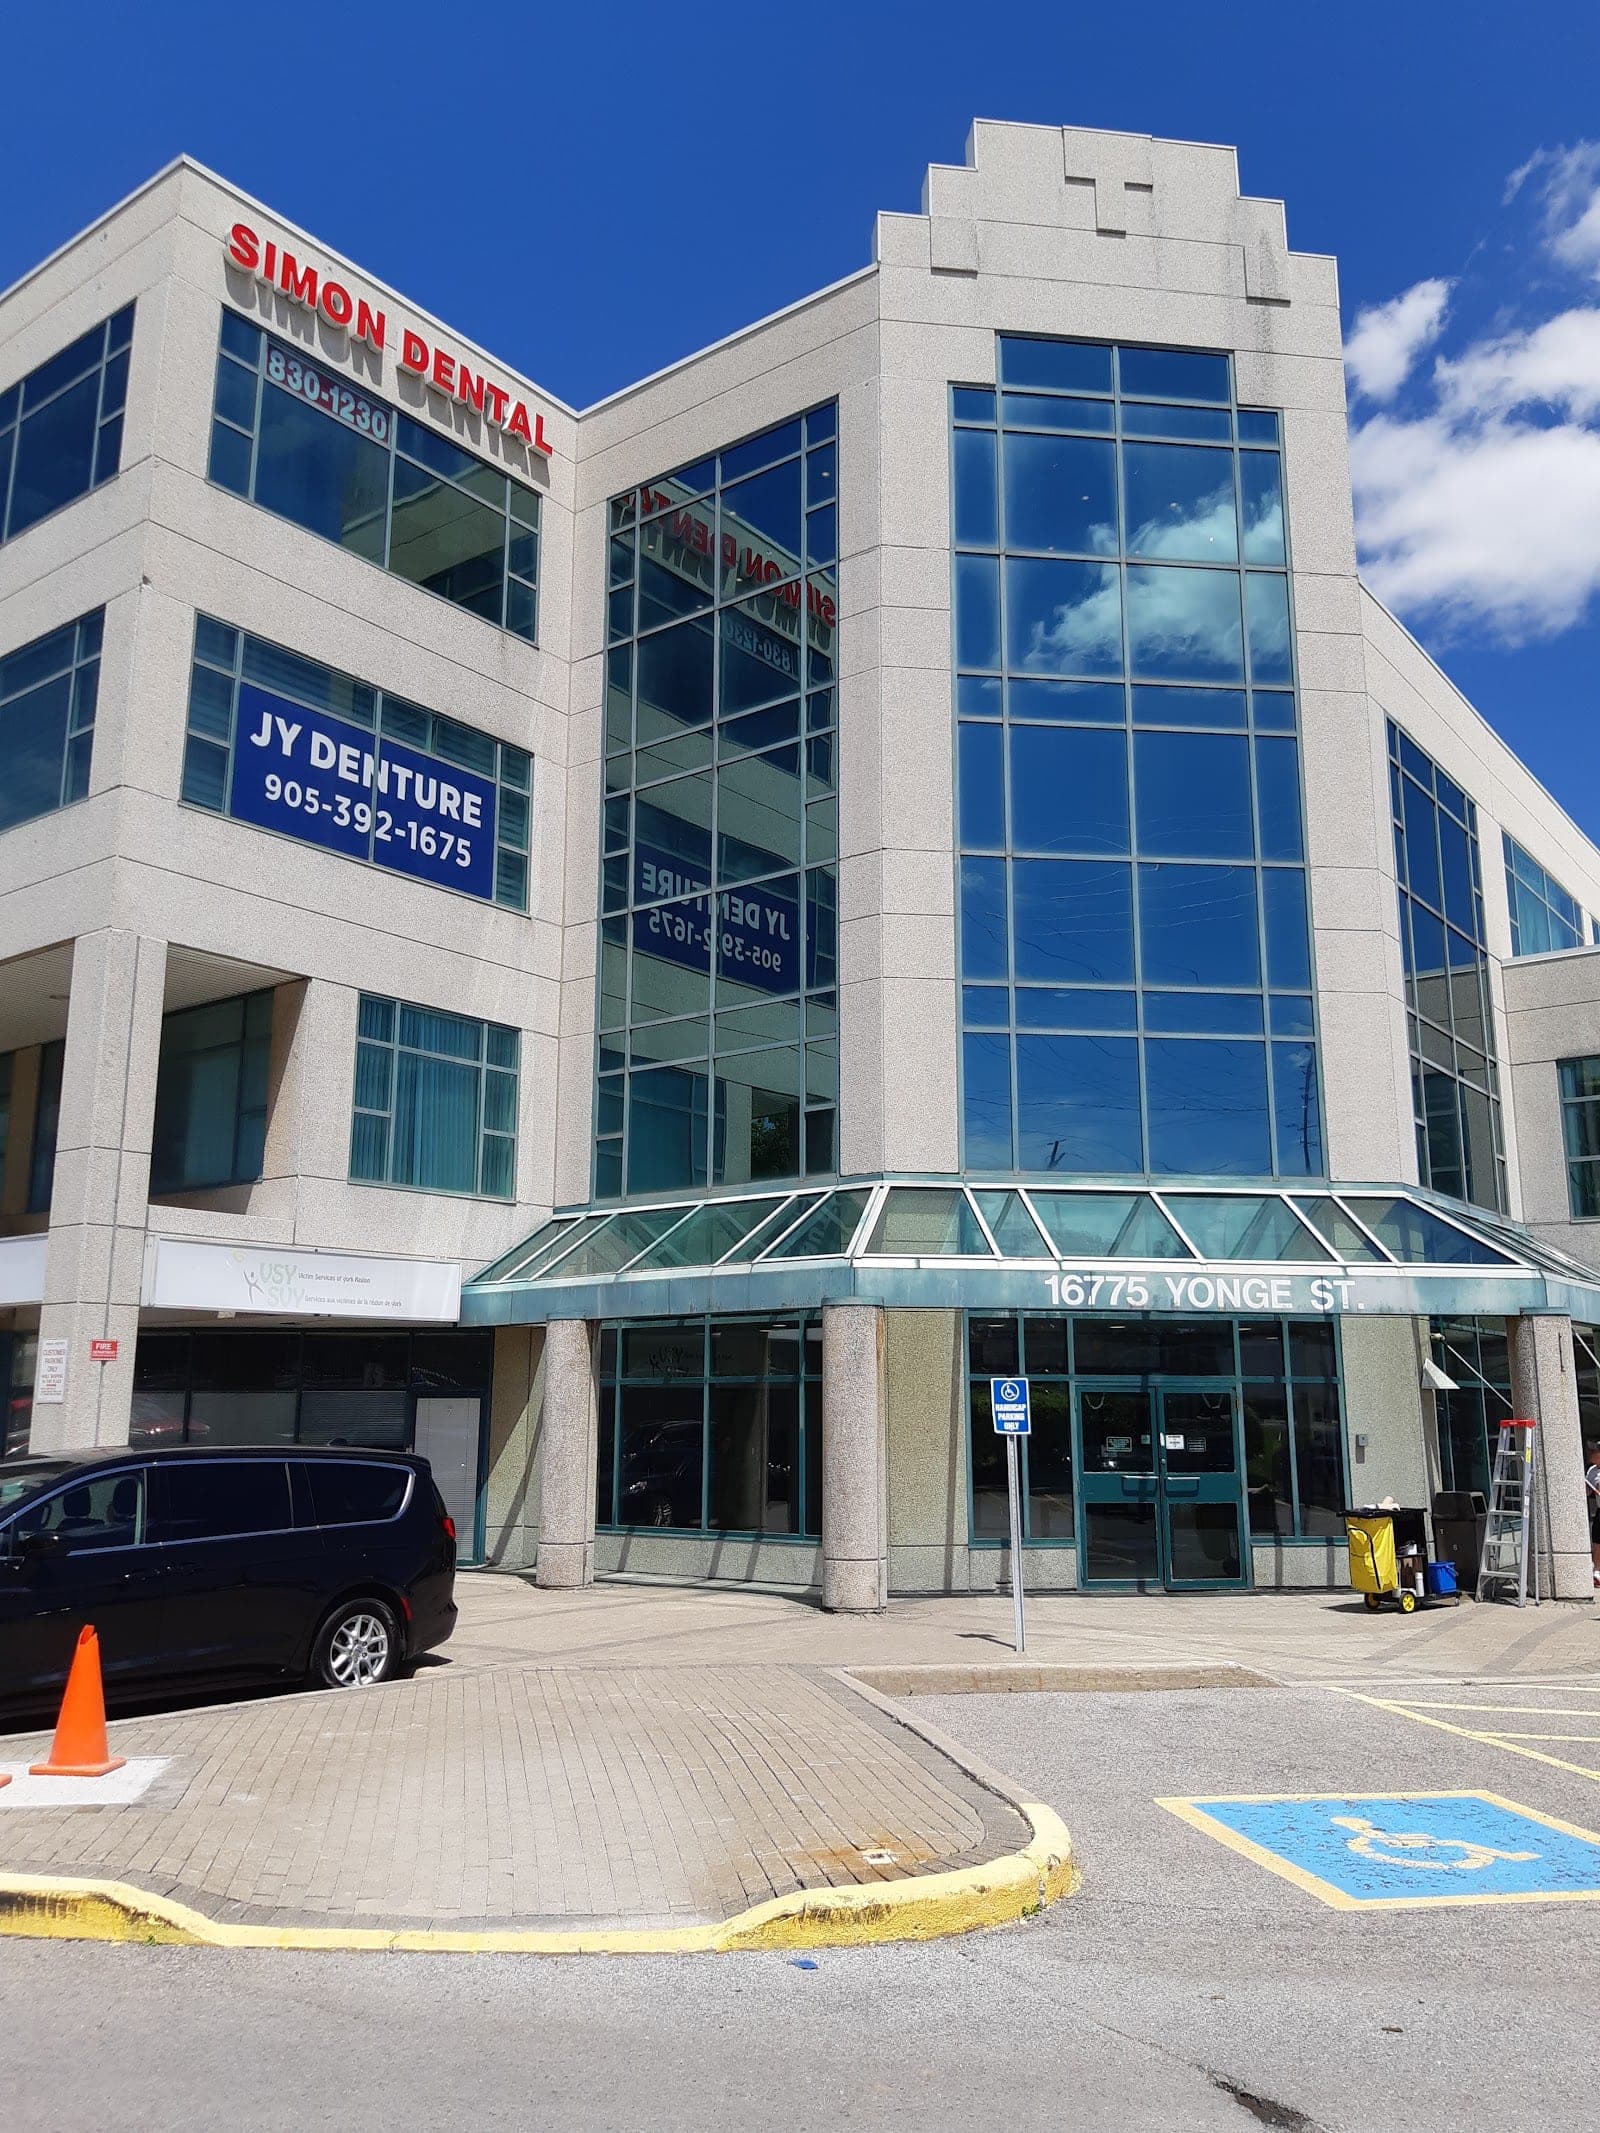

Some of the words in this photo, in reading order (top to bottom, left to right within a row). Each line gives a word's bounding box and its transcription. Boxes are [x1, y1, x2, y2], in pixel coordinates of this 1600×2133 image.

[225, 222, 386, 352] SIMON
[398, 328, 553, 457] DENTAL
[268, 350, 387, 440] 830-1230
[250, 711, 303, 757] JY
[310, 730, 483, 829] DENTURE
[264, 773, 472, 868] 905-392-1675
[1044, 1274, 1149, 1306] 16775
[1165, 1277, 1293, 1310] YONGE
[1310, 1279, 1364, 1311] ST.
[998, 1412, 1025, 1421] PARKING
[1003, 1421, 1020, 1431] ONLY
